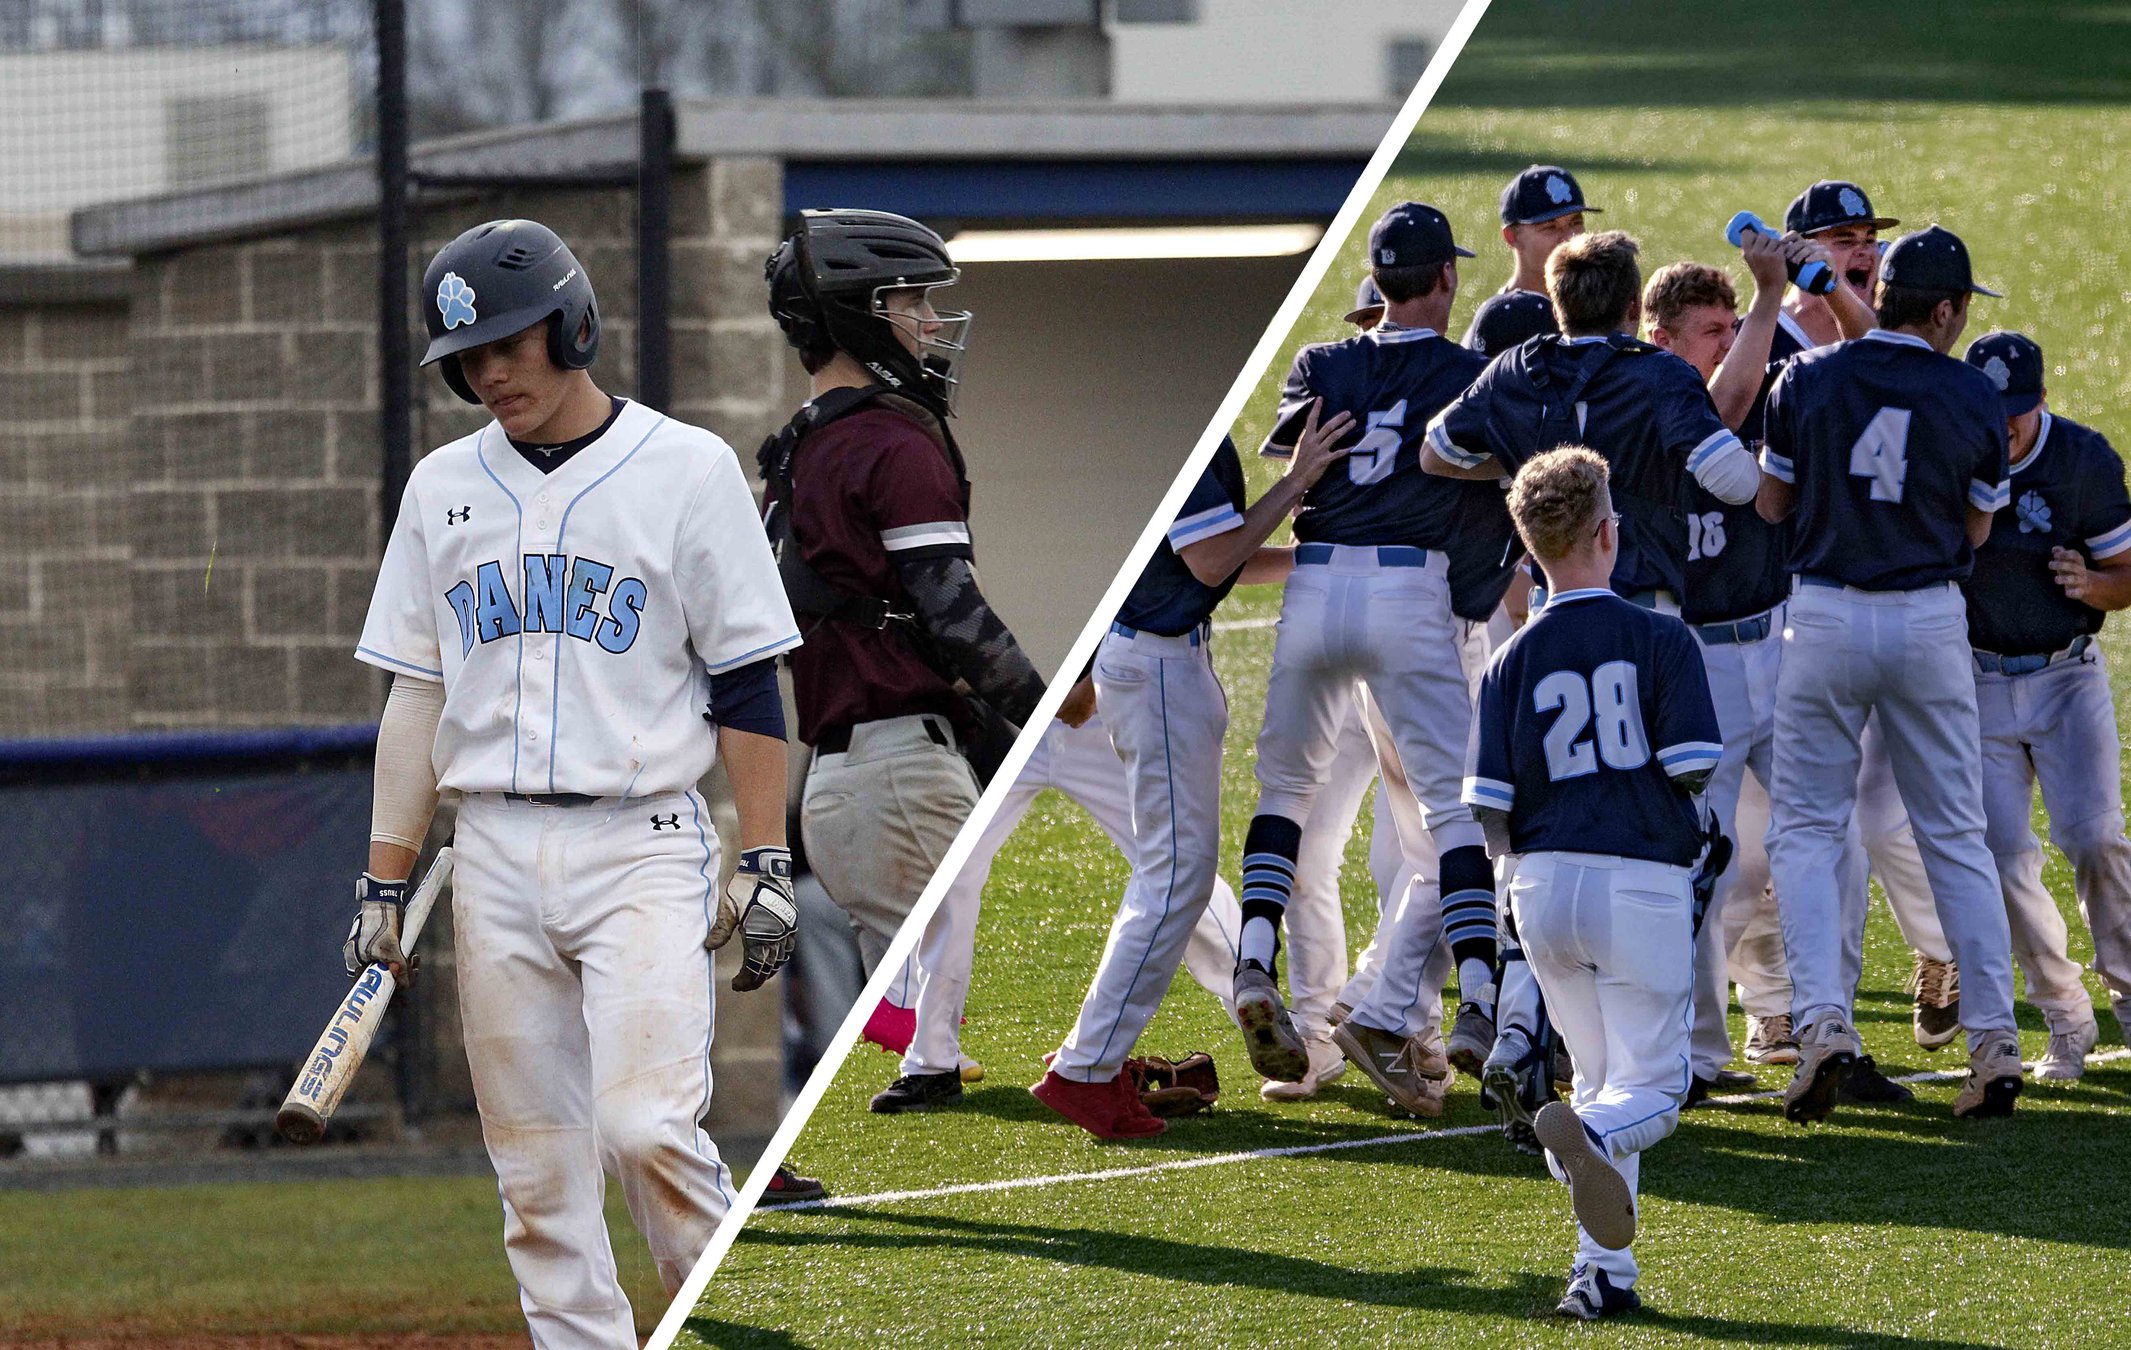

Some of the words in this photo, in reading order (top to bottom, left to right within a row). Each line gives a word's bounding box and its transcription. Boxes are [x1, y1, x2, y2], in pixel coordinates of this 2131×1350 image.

[1348, 398, 1408, 486] 5
[1849, 406, 1912, 504] 4
[1687, 511, 1728, 562] 16
[444, 553, 649, 661] DANES
[1533, 660, 1652, 782] 28
